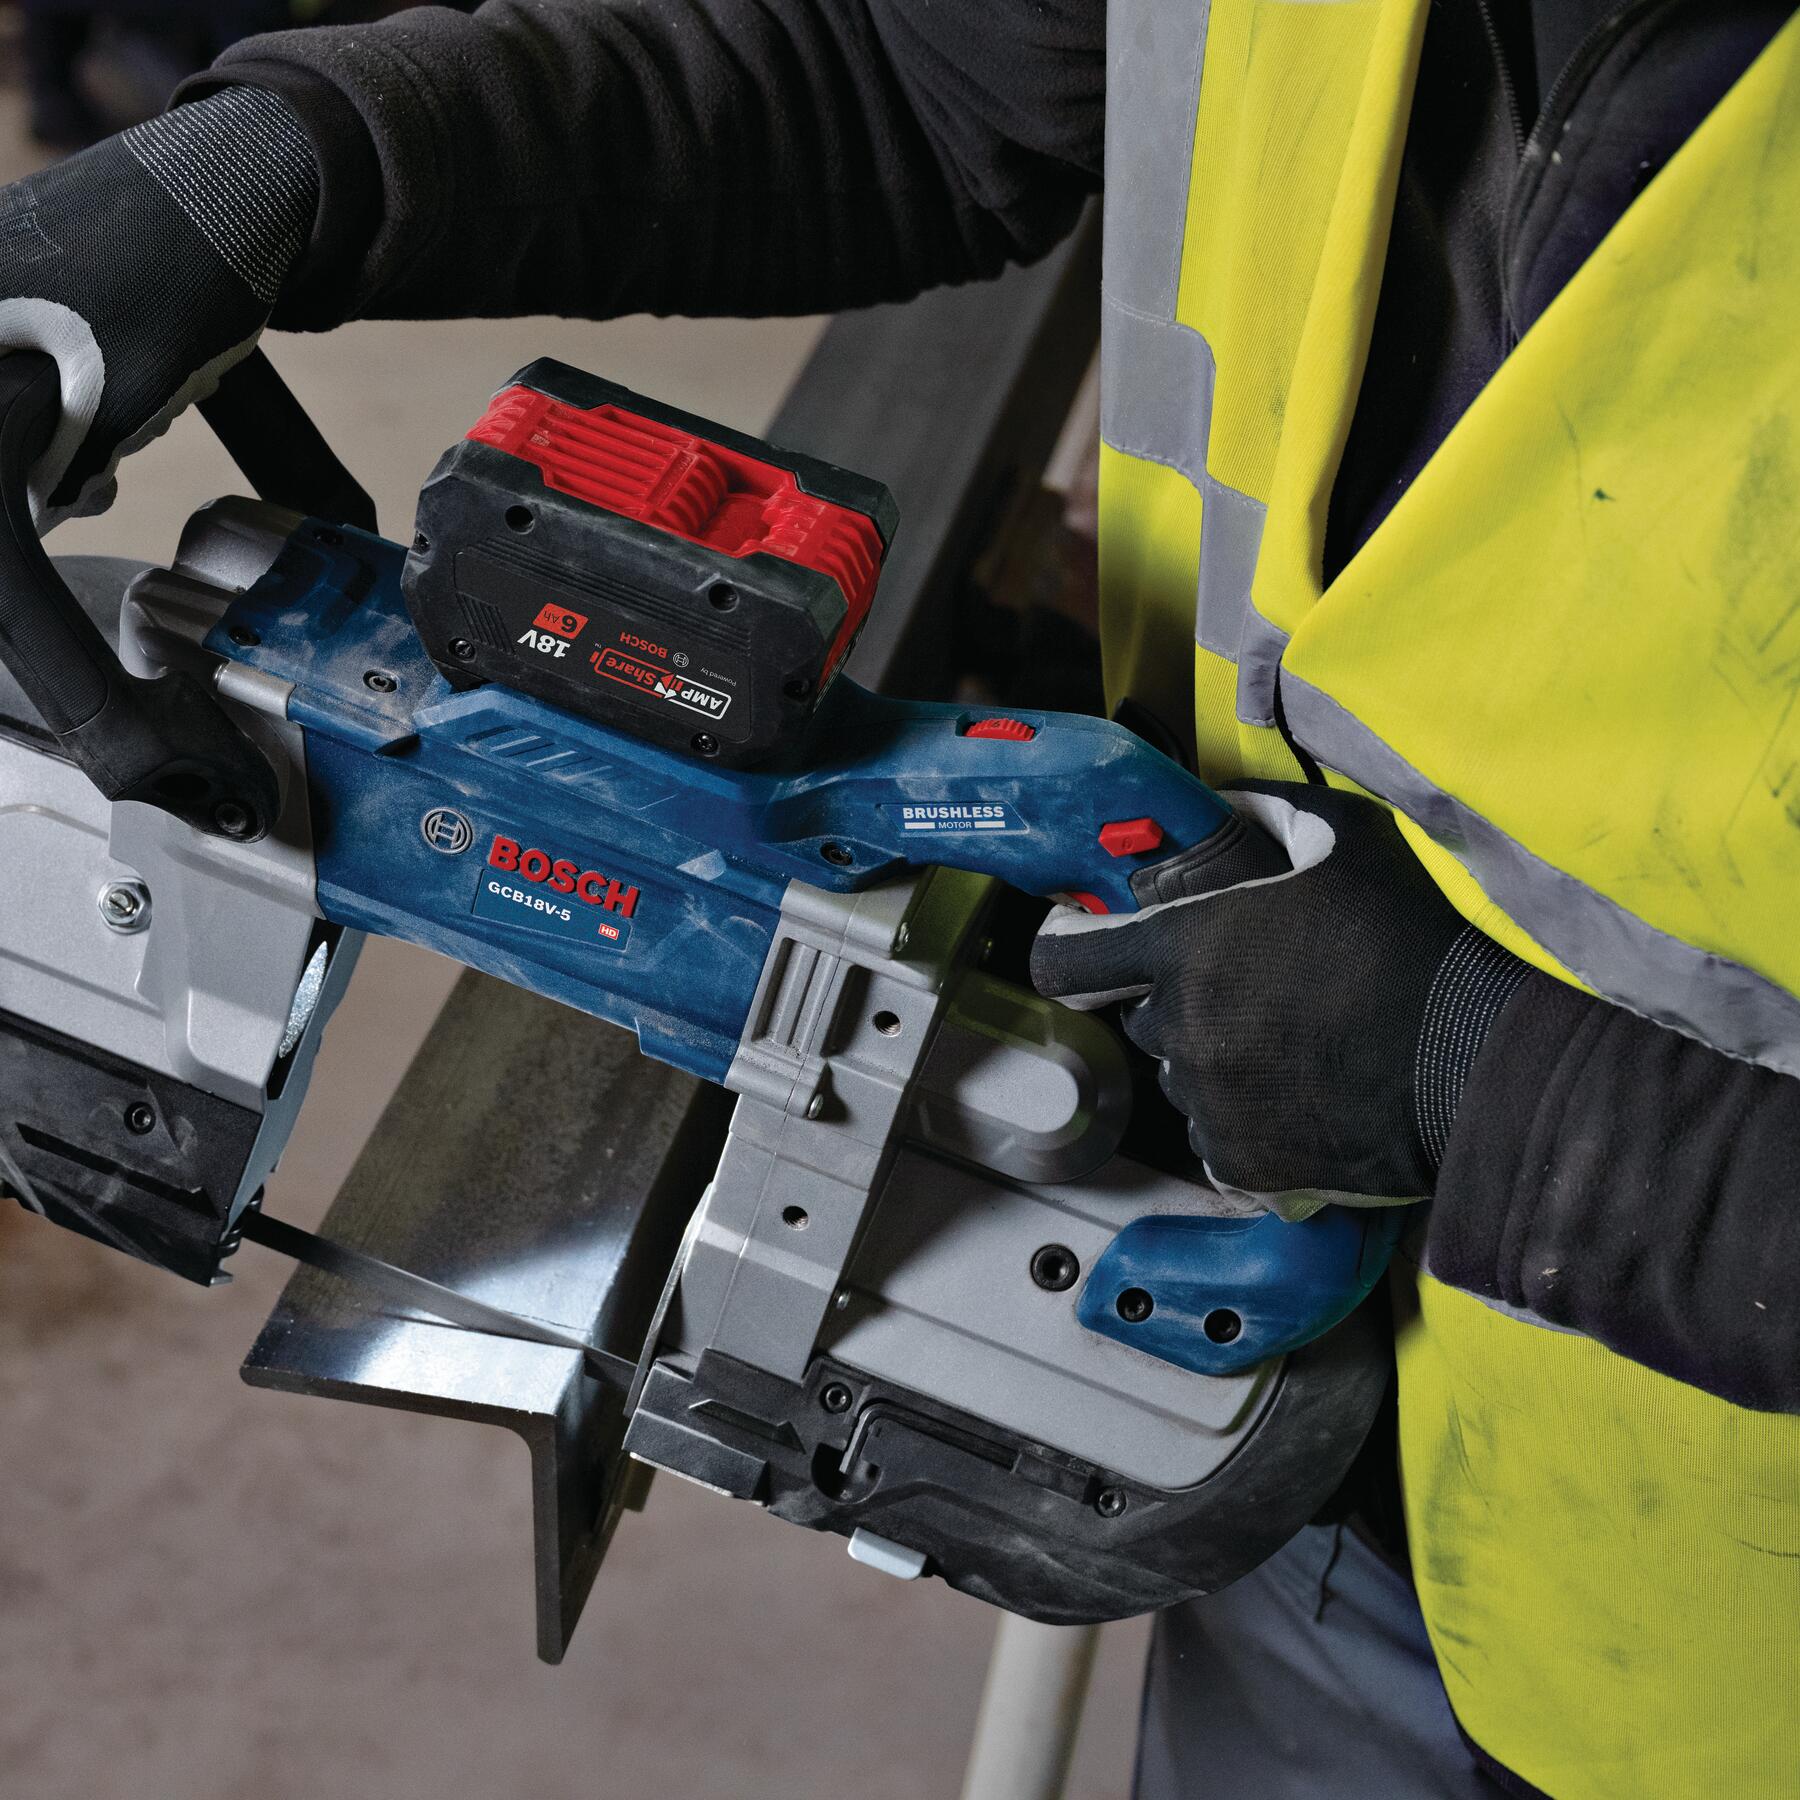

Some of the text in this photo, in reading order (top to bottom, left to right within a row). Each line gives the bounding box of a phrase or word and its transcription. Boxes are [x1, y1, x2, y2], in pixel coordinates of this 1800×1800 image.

[544, 611, 577, 633] 6 Ah
[517, 630, 571, 657] 18V
[620, 632, 668, 658] BOSCH
[605, 656, 656, 686] Share
[701, 667, 736, 686] Powered by
[681, 689, 723, 709] AMP
[903, 806, 1004, 819] BRUSHLESS
[938, 821, 972, 829] MOTOR
[488, 835, 641, 918] BOSCH
[488, 881, 571, 921] GCB18V-5
[601, 925, 617, 937] HD
